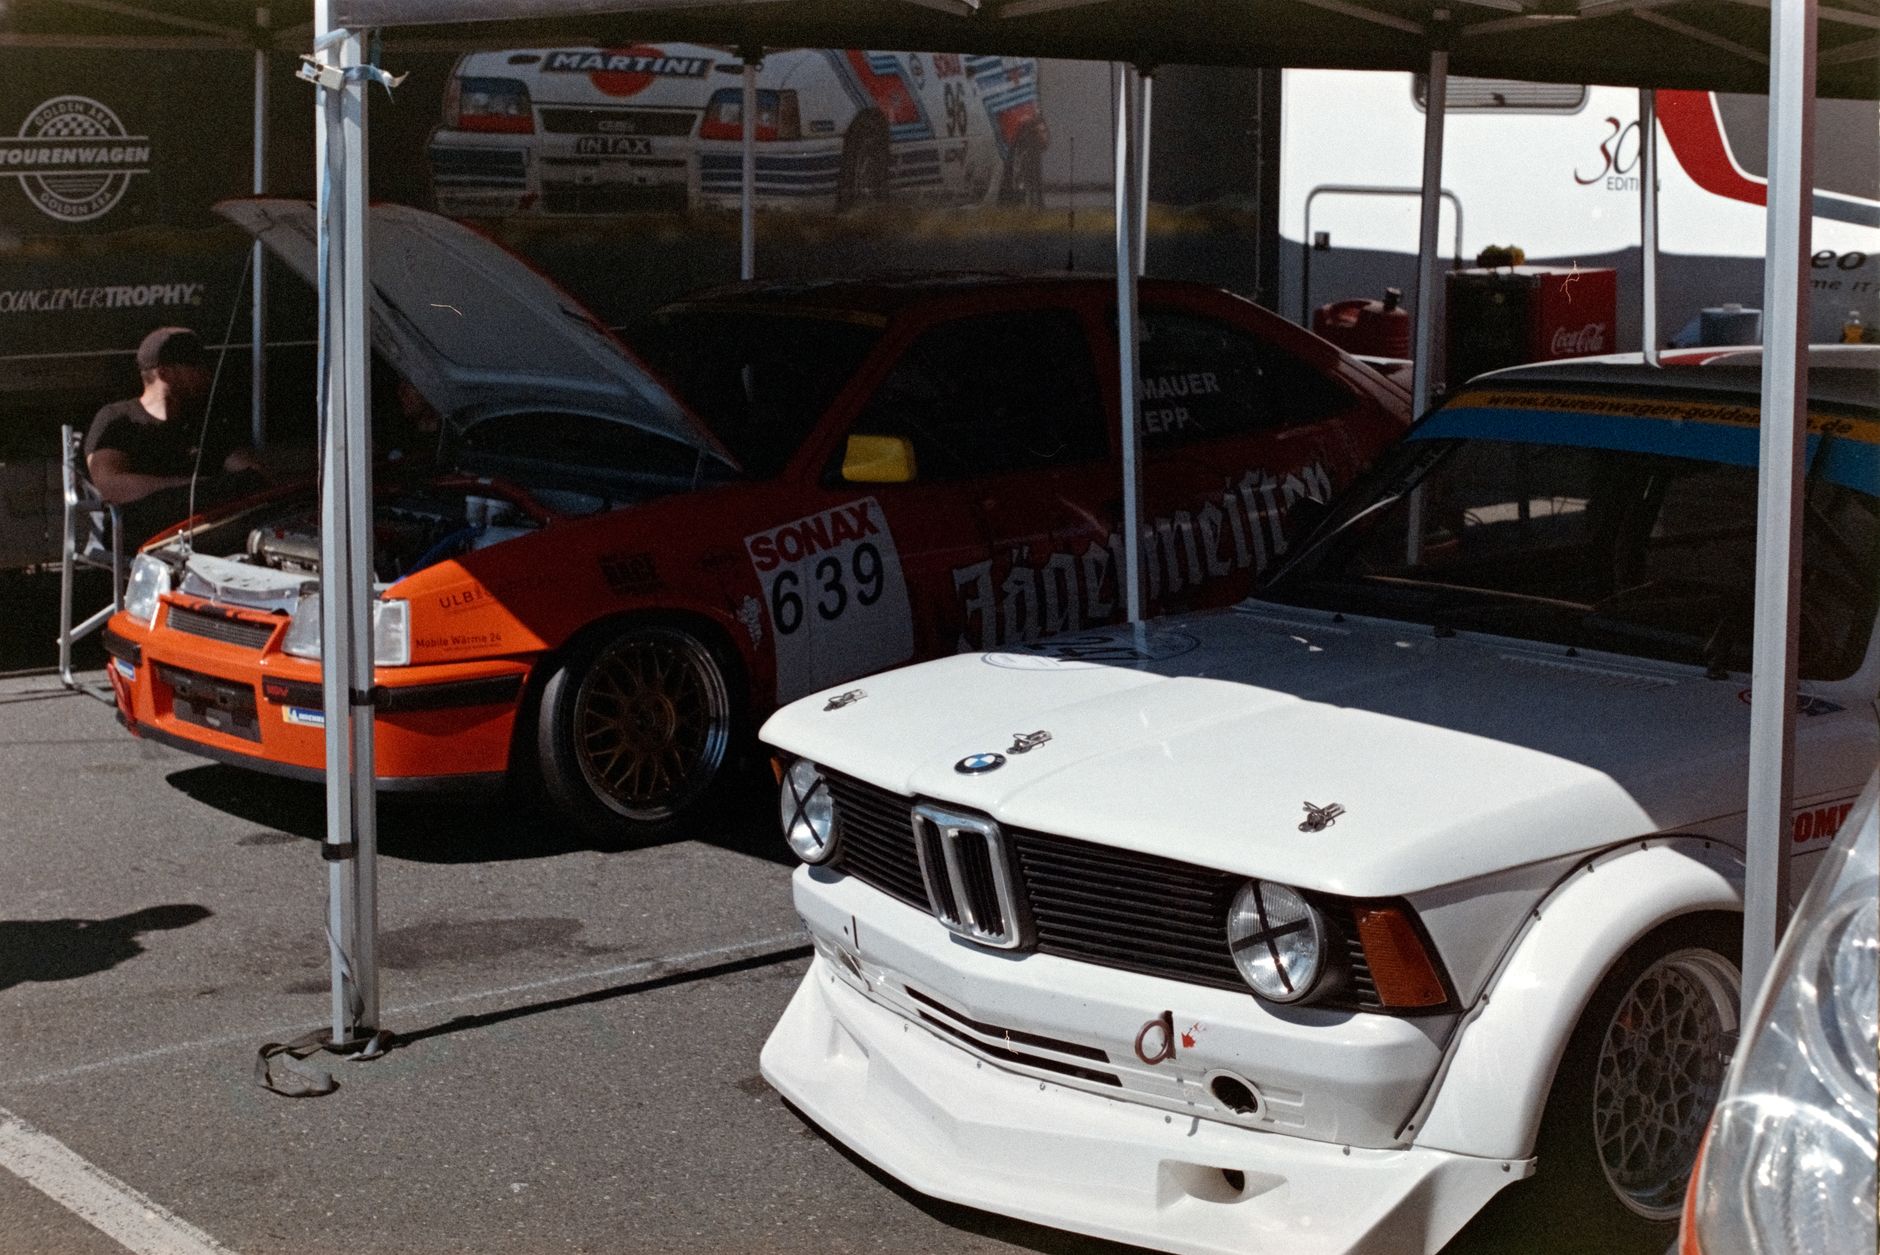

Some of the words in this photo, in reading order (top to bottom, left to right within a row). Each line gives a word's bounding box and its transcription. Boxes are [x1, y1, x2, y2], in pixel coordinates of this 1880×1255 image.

[552, 53, 703, 75] MARTINI
[35, 102, 84, 127] GOLDEN
[944, 82, 967, 137] 96
[0, 146, 150, 165] TOURENWAGEN
[579, 138, 648, 155] INTAX
[1574, 117, 1641, 185] 30
[1606, 175, 1661, 192] EDITI
[1811, 249, 1867, 271] eo
[749, 501, 880, 572] SONAX
[772, 541, 884, 635] 639
[1792, 802, 1855, 843] OM
